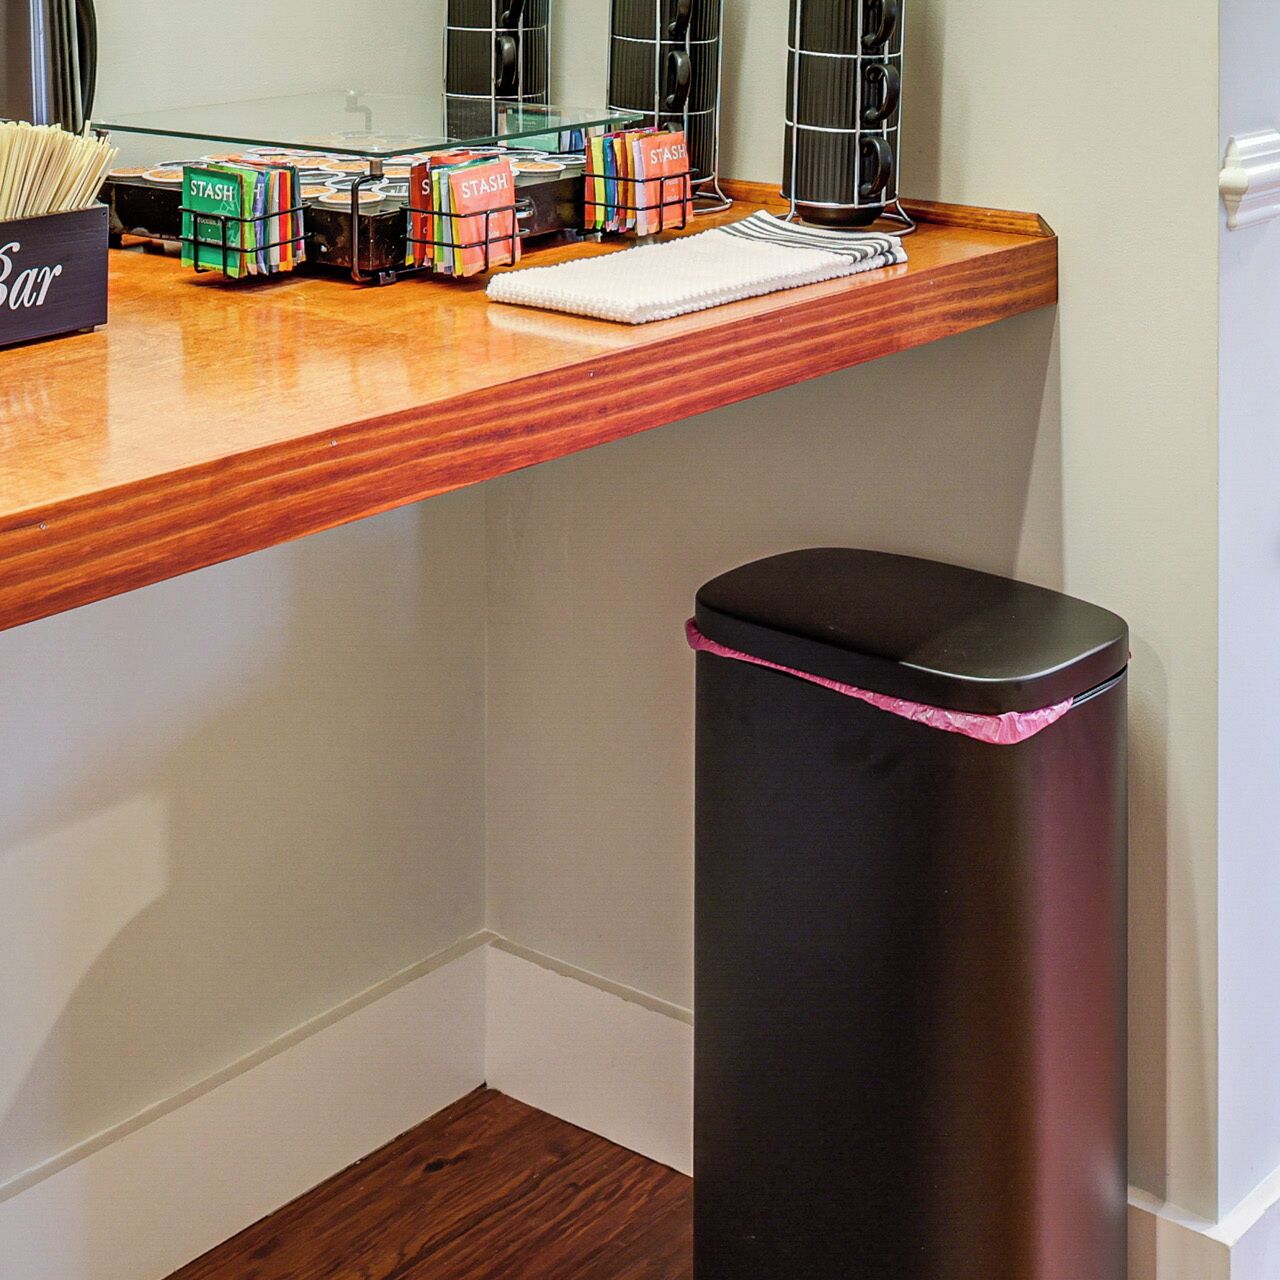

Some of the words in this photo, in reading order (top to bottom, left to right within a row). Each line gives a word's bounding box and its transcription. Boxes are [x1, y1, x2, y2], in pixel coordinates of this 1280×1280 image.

[650, 143, 687, 164] STASH
[190, 180, 234, 201] STASH
[461, 172, 508, 199] STASH
